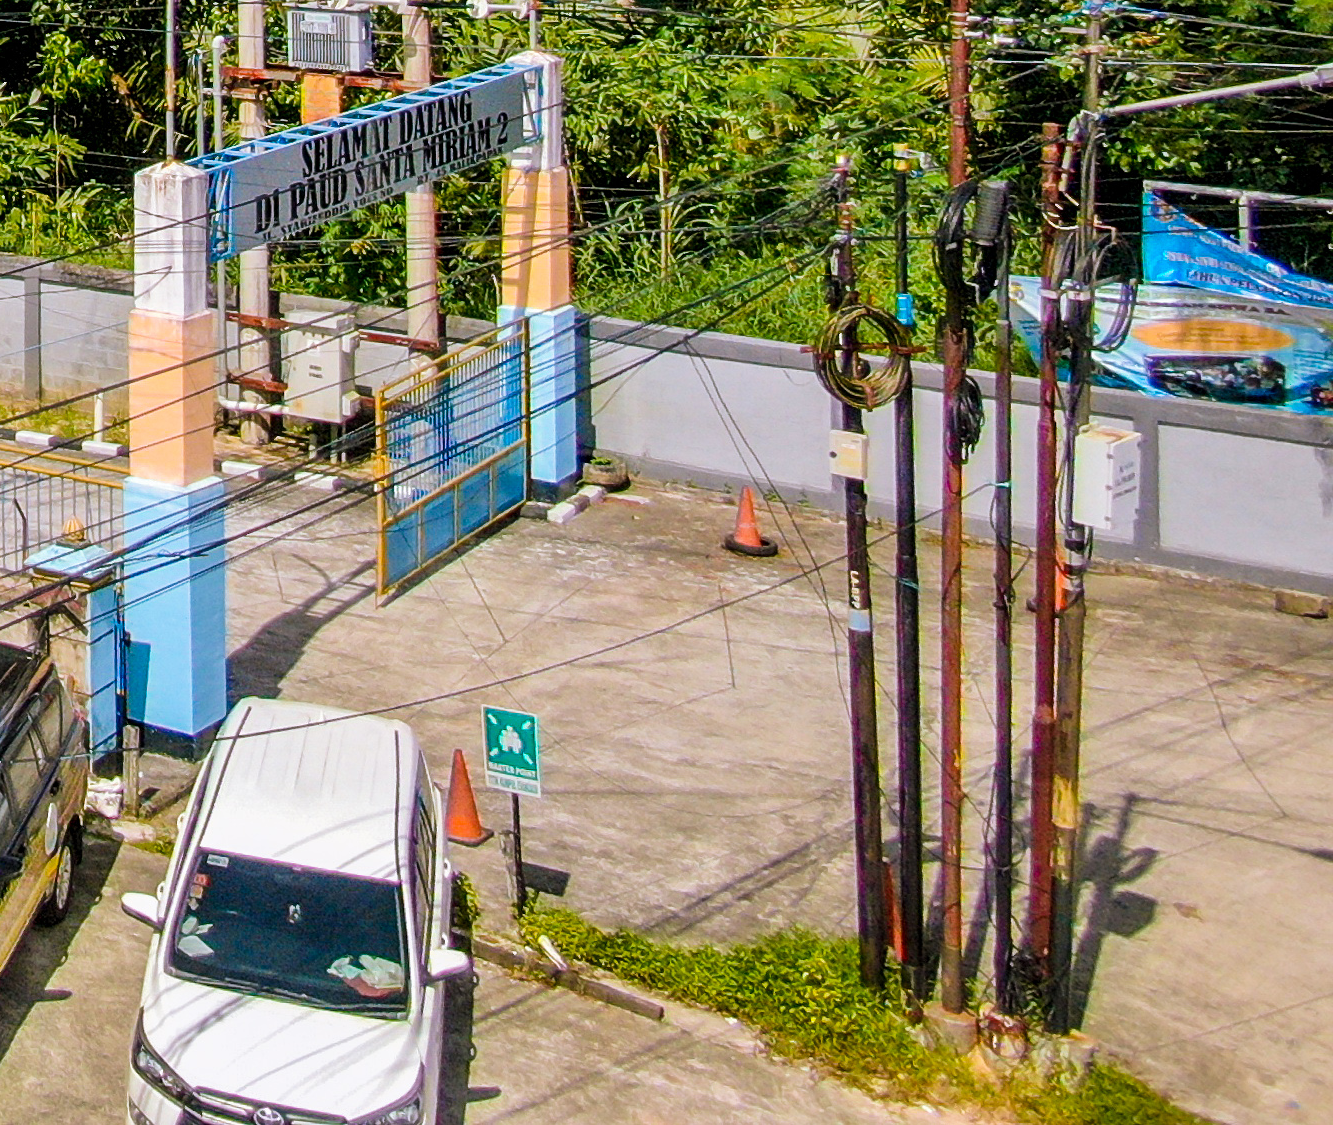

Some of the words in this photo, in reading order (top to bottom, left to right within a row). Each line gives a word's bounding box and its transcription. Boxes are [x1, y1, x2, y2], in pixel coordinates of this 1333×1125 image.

[254, 188, 280, 235] DI
[289, 168, 348, 221] PAUD
[355, 150, 417, 195] SANTA
[423, 123, 491, 174] MIRIAM
[497, 111, 508, 145] 2
[301, 110, 393, 177] SELAMAT
[399, 90, 472, 142] DATANG
